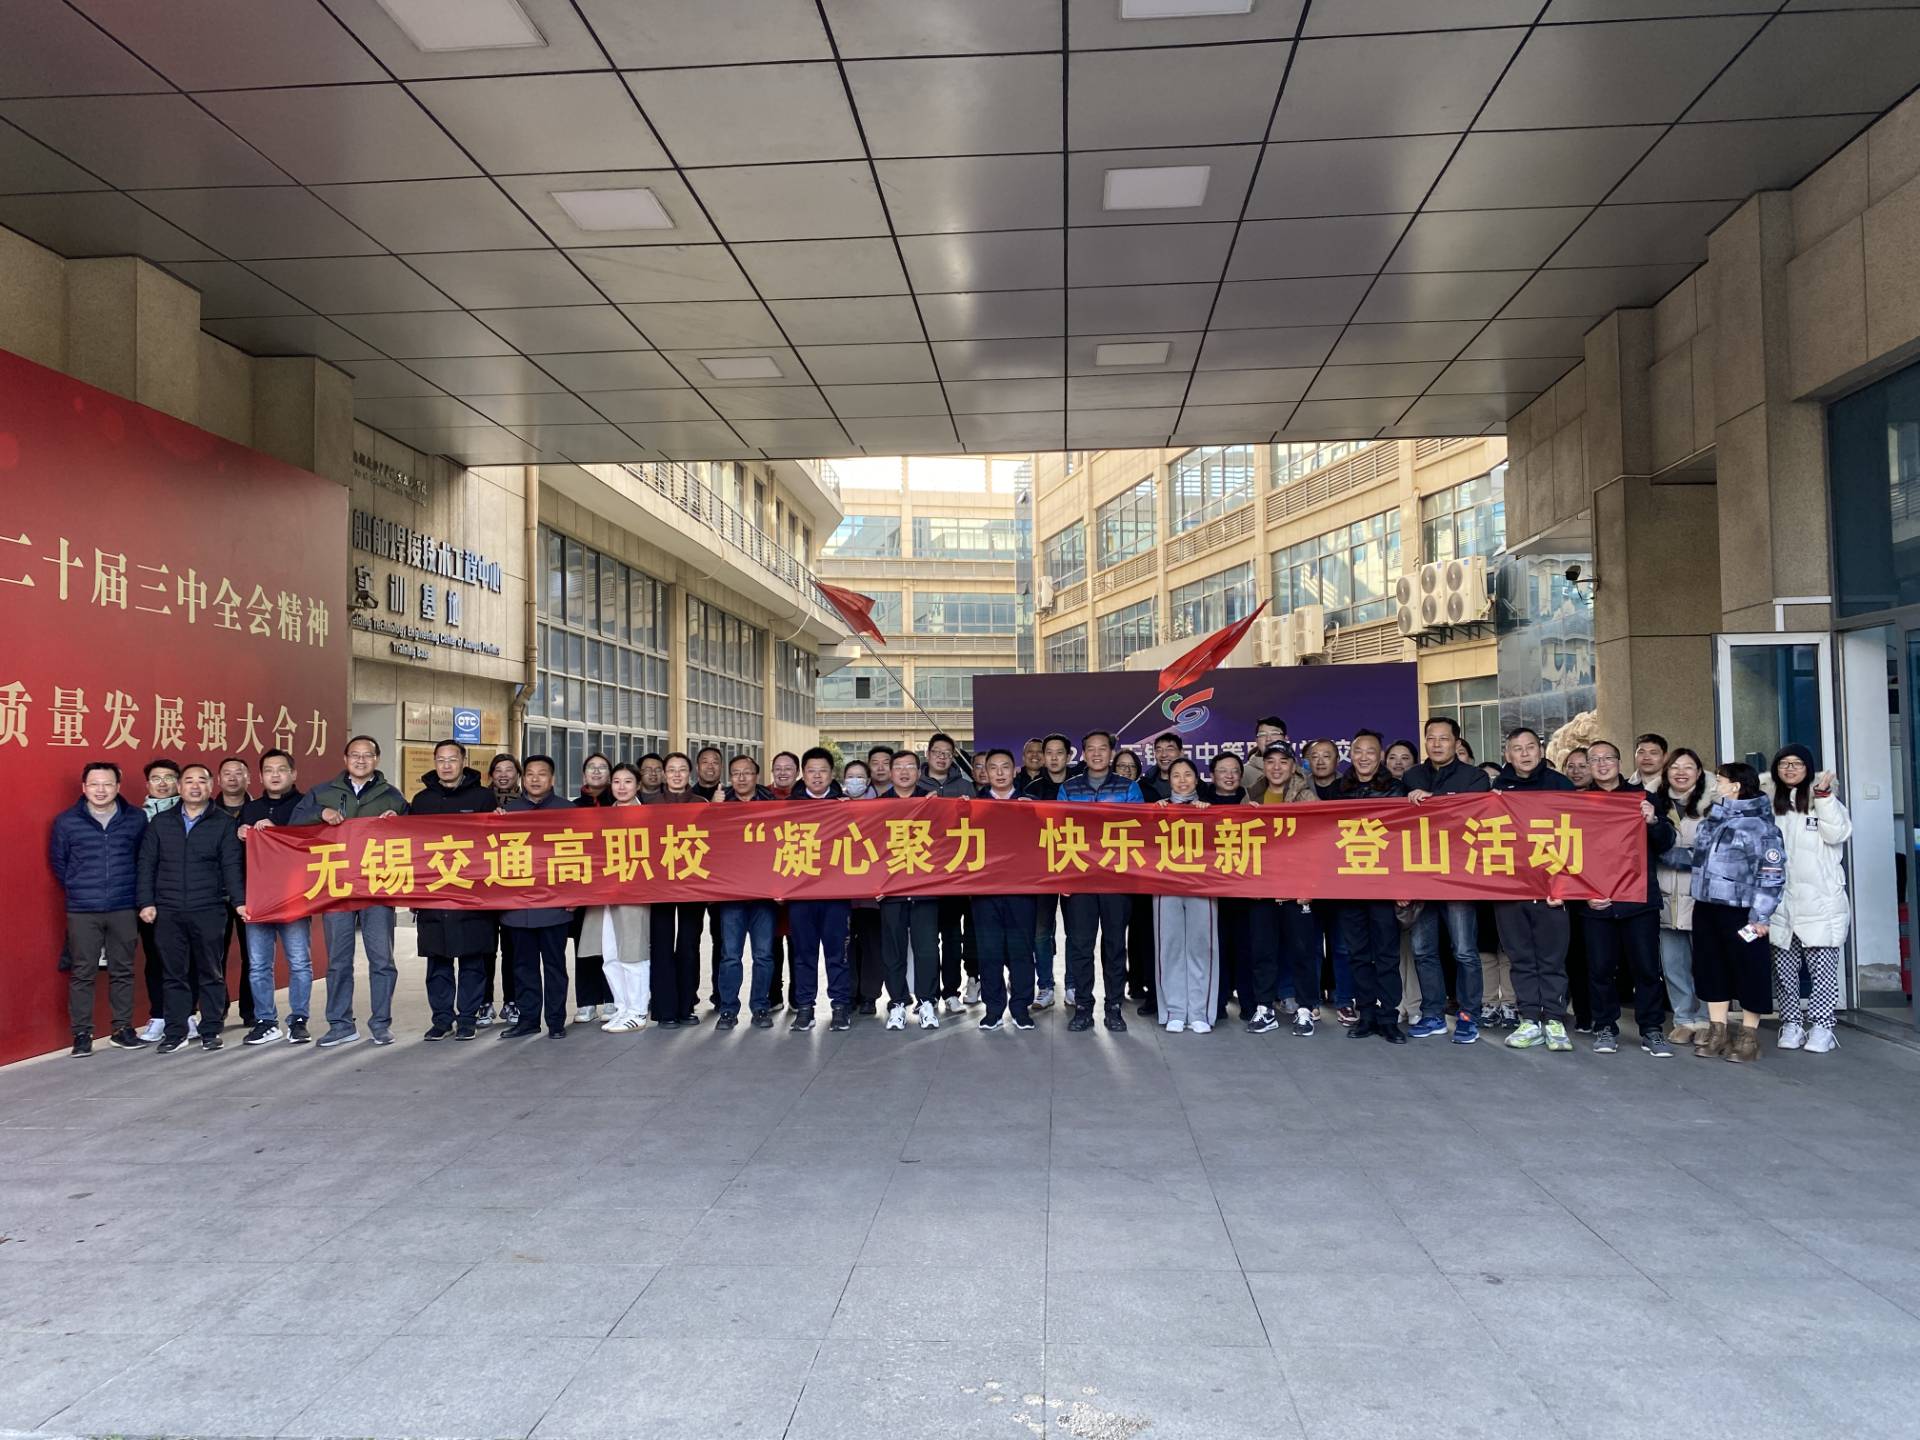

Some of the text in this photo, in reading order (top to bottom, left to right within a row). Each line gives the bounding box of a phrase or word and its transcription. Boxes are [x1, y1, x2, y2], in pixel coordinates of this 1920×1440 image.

[0, 533, 329, 647] 二十届三中全会精神
[353, 509, 501, 594] 船舶焊接技术工程中心
[0, 681, 328, 756] 质量发展强大合力
[458, 715, 477, 727] OTC
[304, 822, 710, 900] 无锡交通高职校
[1337, 813, 1584, 876] 登山活动
